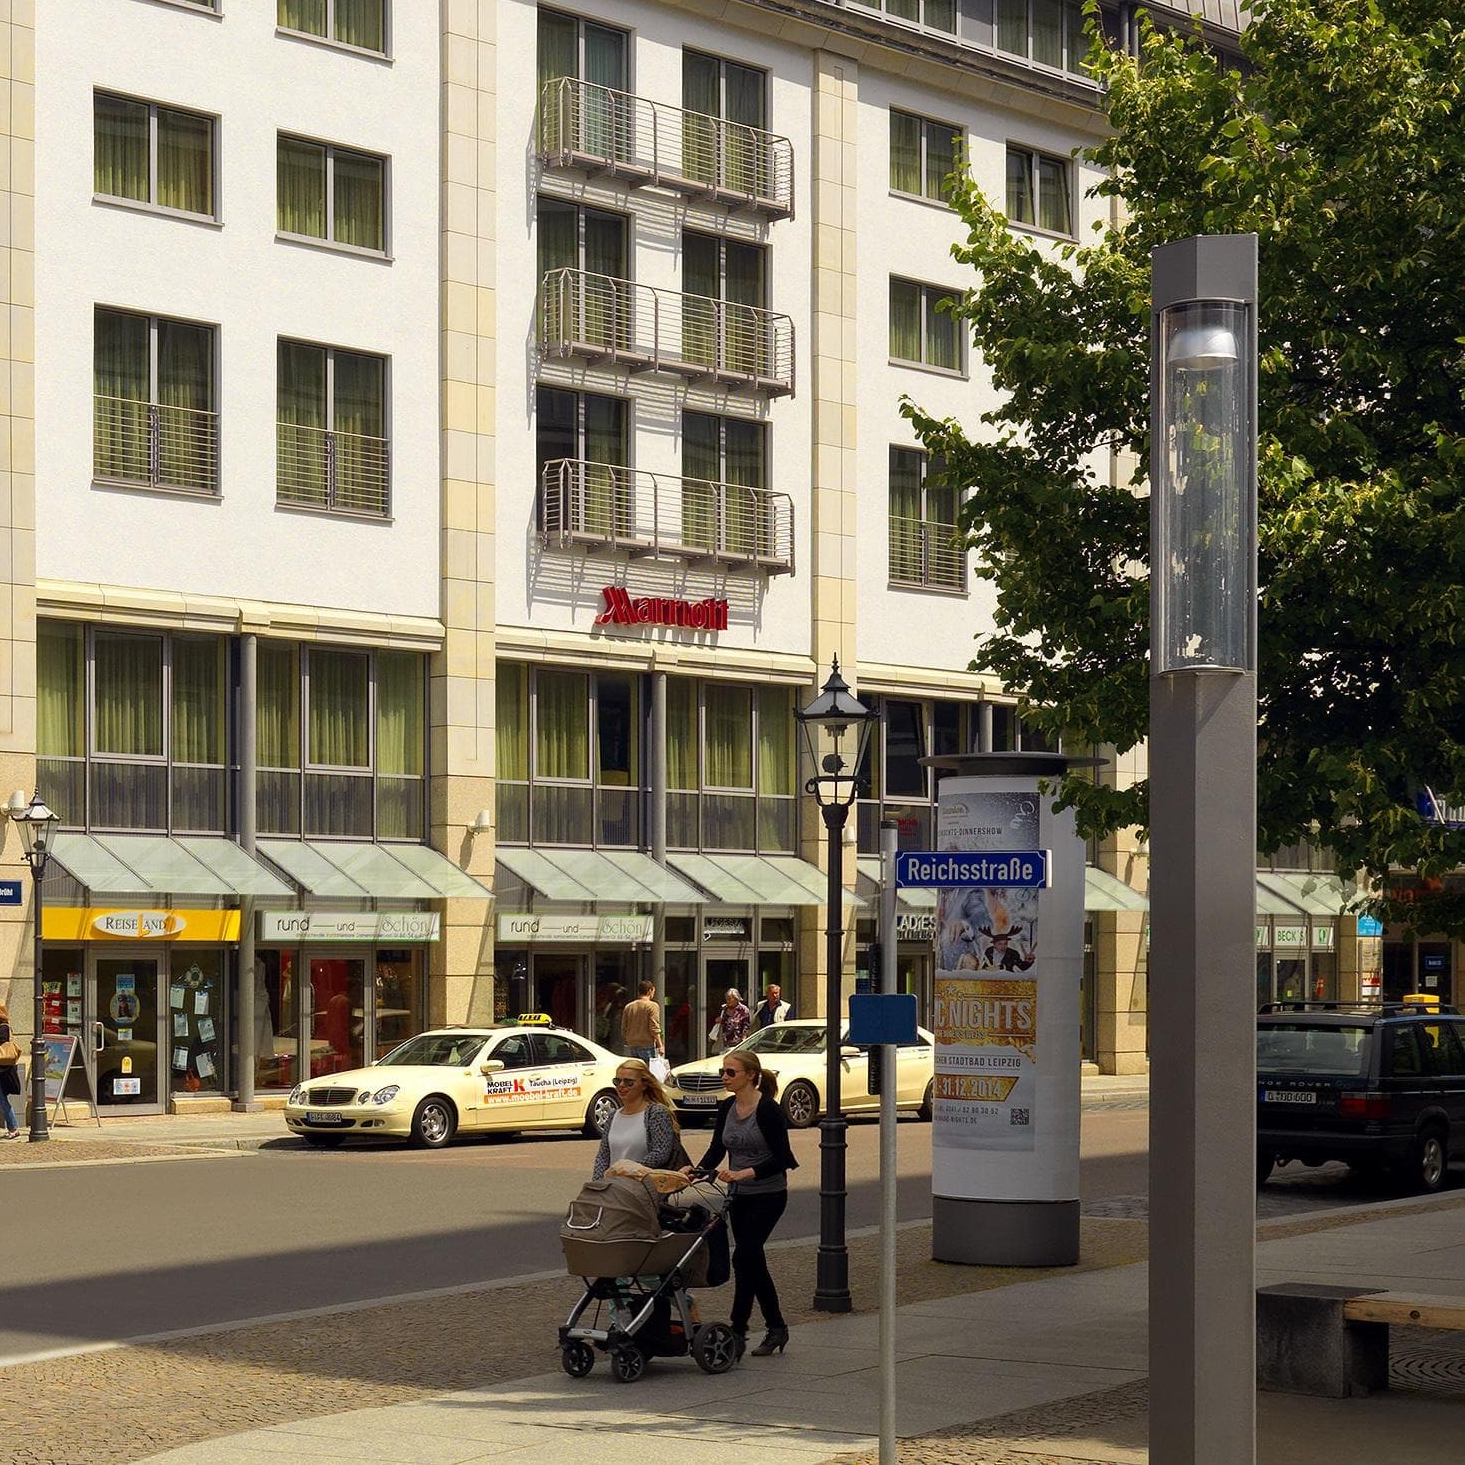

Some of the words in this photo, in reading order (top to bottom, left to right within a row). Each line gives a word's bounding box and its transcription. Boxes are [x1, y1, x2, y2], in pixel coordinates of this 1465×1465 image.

[595, 586, 729, 630] Marriott
[908, 857, 1033, 880] Reichsstraße
[277, 917, 310, 931] rund
[336, 921, 355, 931] und
[381, 916, 428, 933] Schön
[510, 918, 540, 933] rund
[563, 923, 580, 934] und
[949, 999, 1032, 1030] NIGHTS
[948, 1055, 985, 1066] STADTBAD
[988, 1058, 1021, 1068] LEIPZIG
[552, 1077, 578, 1086] (Leipzig)
[943, 1077, 1002, 1097] 31.12.2014
[487, 1090, 579, 1104] www.moebel-kraft.de
